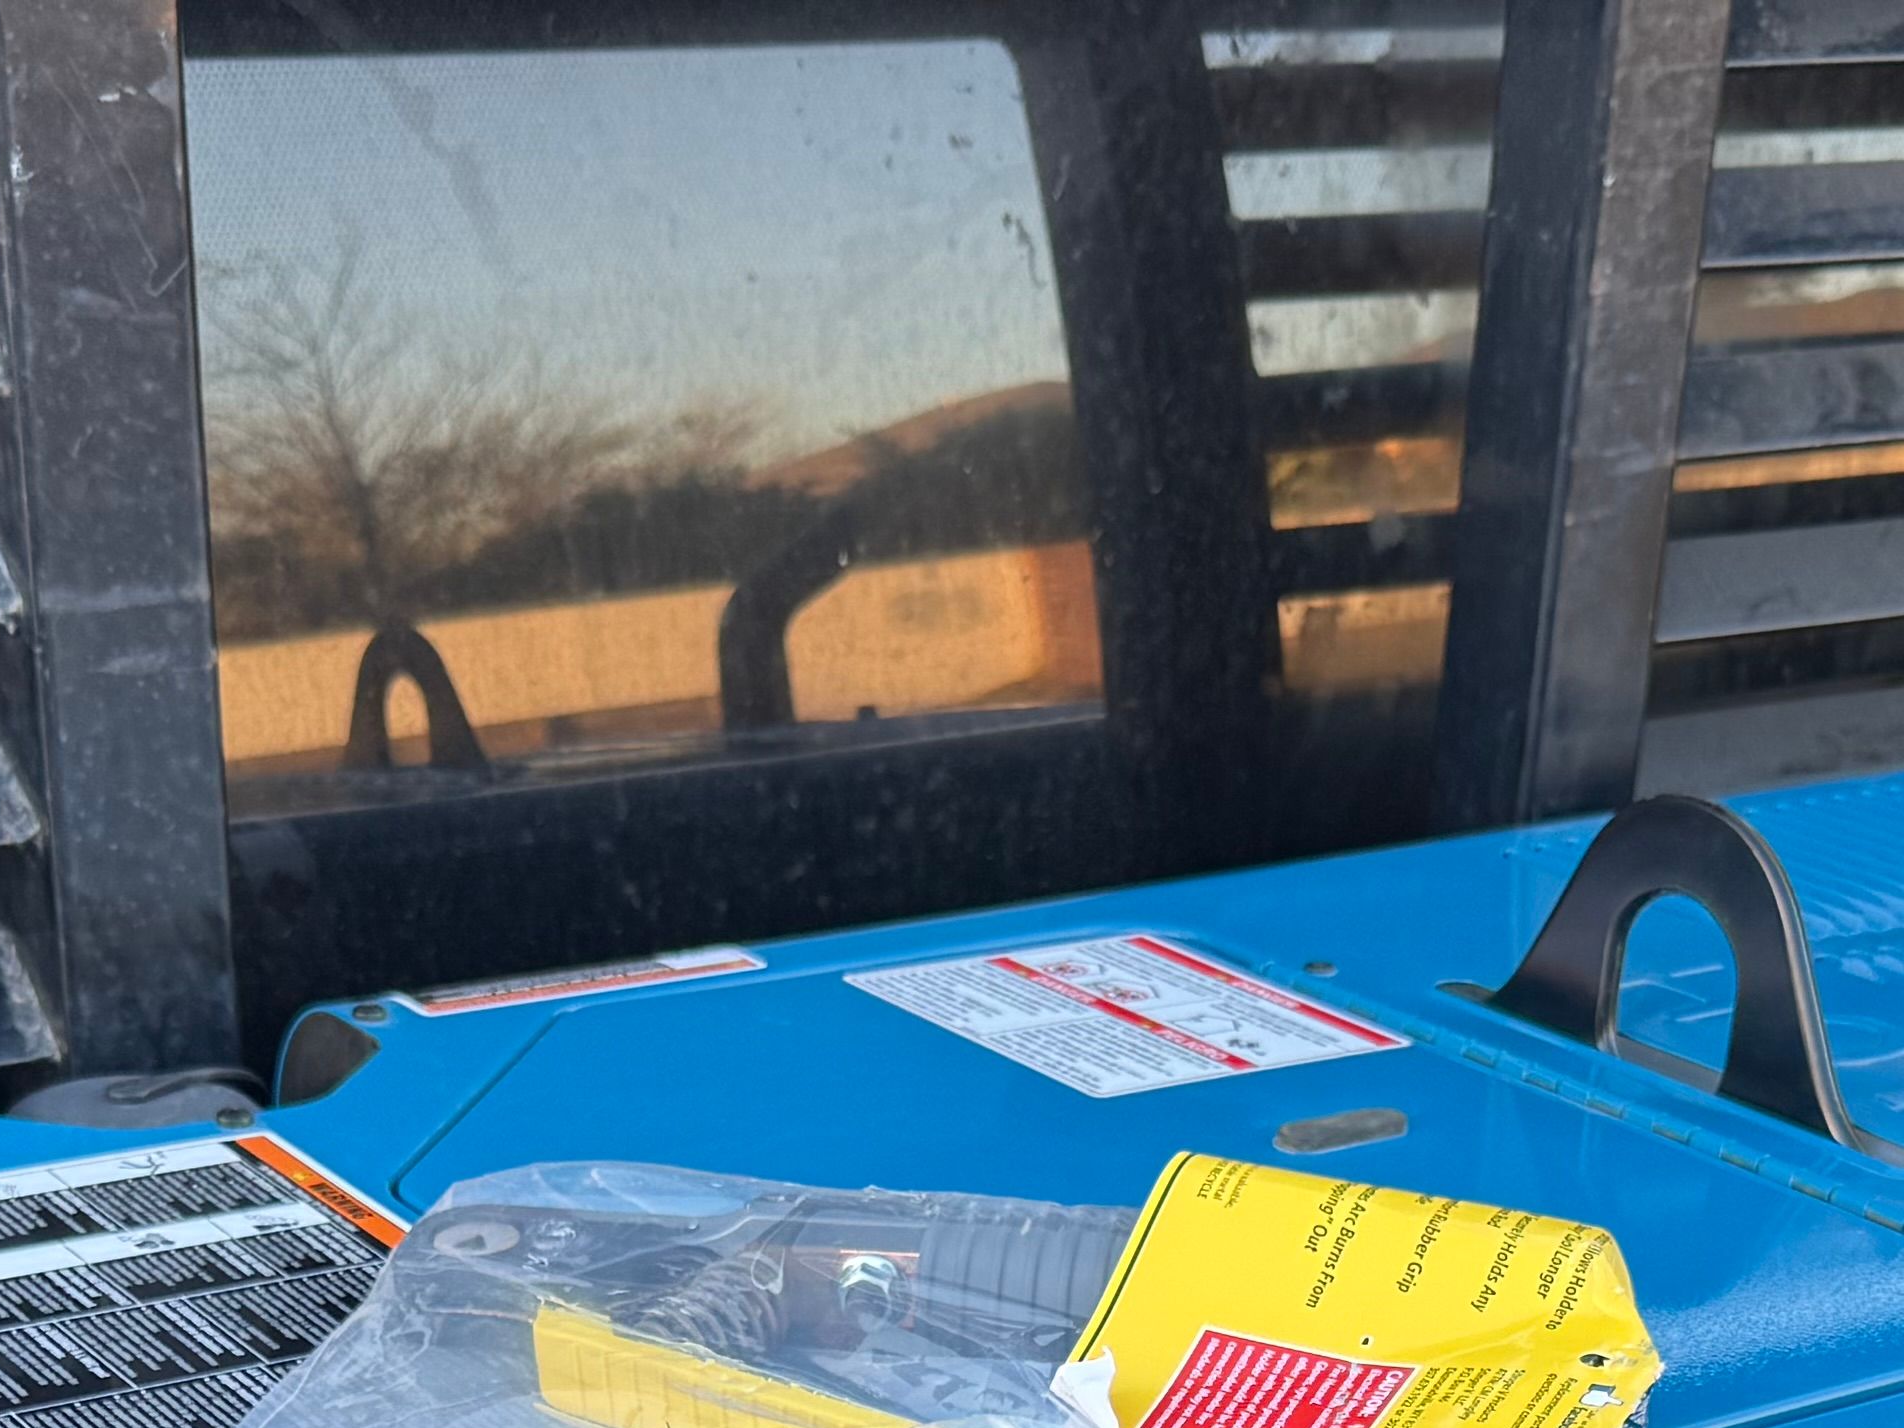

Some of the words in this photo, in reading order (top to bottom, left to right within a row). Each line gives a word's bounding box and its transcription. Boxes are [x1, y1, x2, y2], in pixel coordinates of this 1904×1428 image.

[1151, 1029, 1236, 1061] PELIGRO
[307, 1180, 374, 1224] WARNING
[1344, 1202, 1365, 1225] Arc
[1304, 1224, 1327, 1252] Out
[1324, 1226, 1354, 1269] Burns
[1414, 1214, 1447, 1259] Rubber
[1397, 1262, 1422, 1292] Grip
[1487, 1241, 1516, 1282] Holds
[1537, 1250, 1569, 1298] Longer
[1306, 1271, 1334, 1307] From
[1470, 1287, 1496, 1312] Any
[1554, 1275, 1585, 1319] Holder
[1545, 1319, 1561, 1329] to
[1251, 1349, 1274, 1376] Holder
[1233, 1376, 1255, 1402] should
[1358, 1370, 1403, 1416] CAUTION:
[1223, 1401, 1238, 1414] not
[1476, 1395, 1504, 1422] Products
